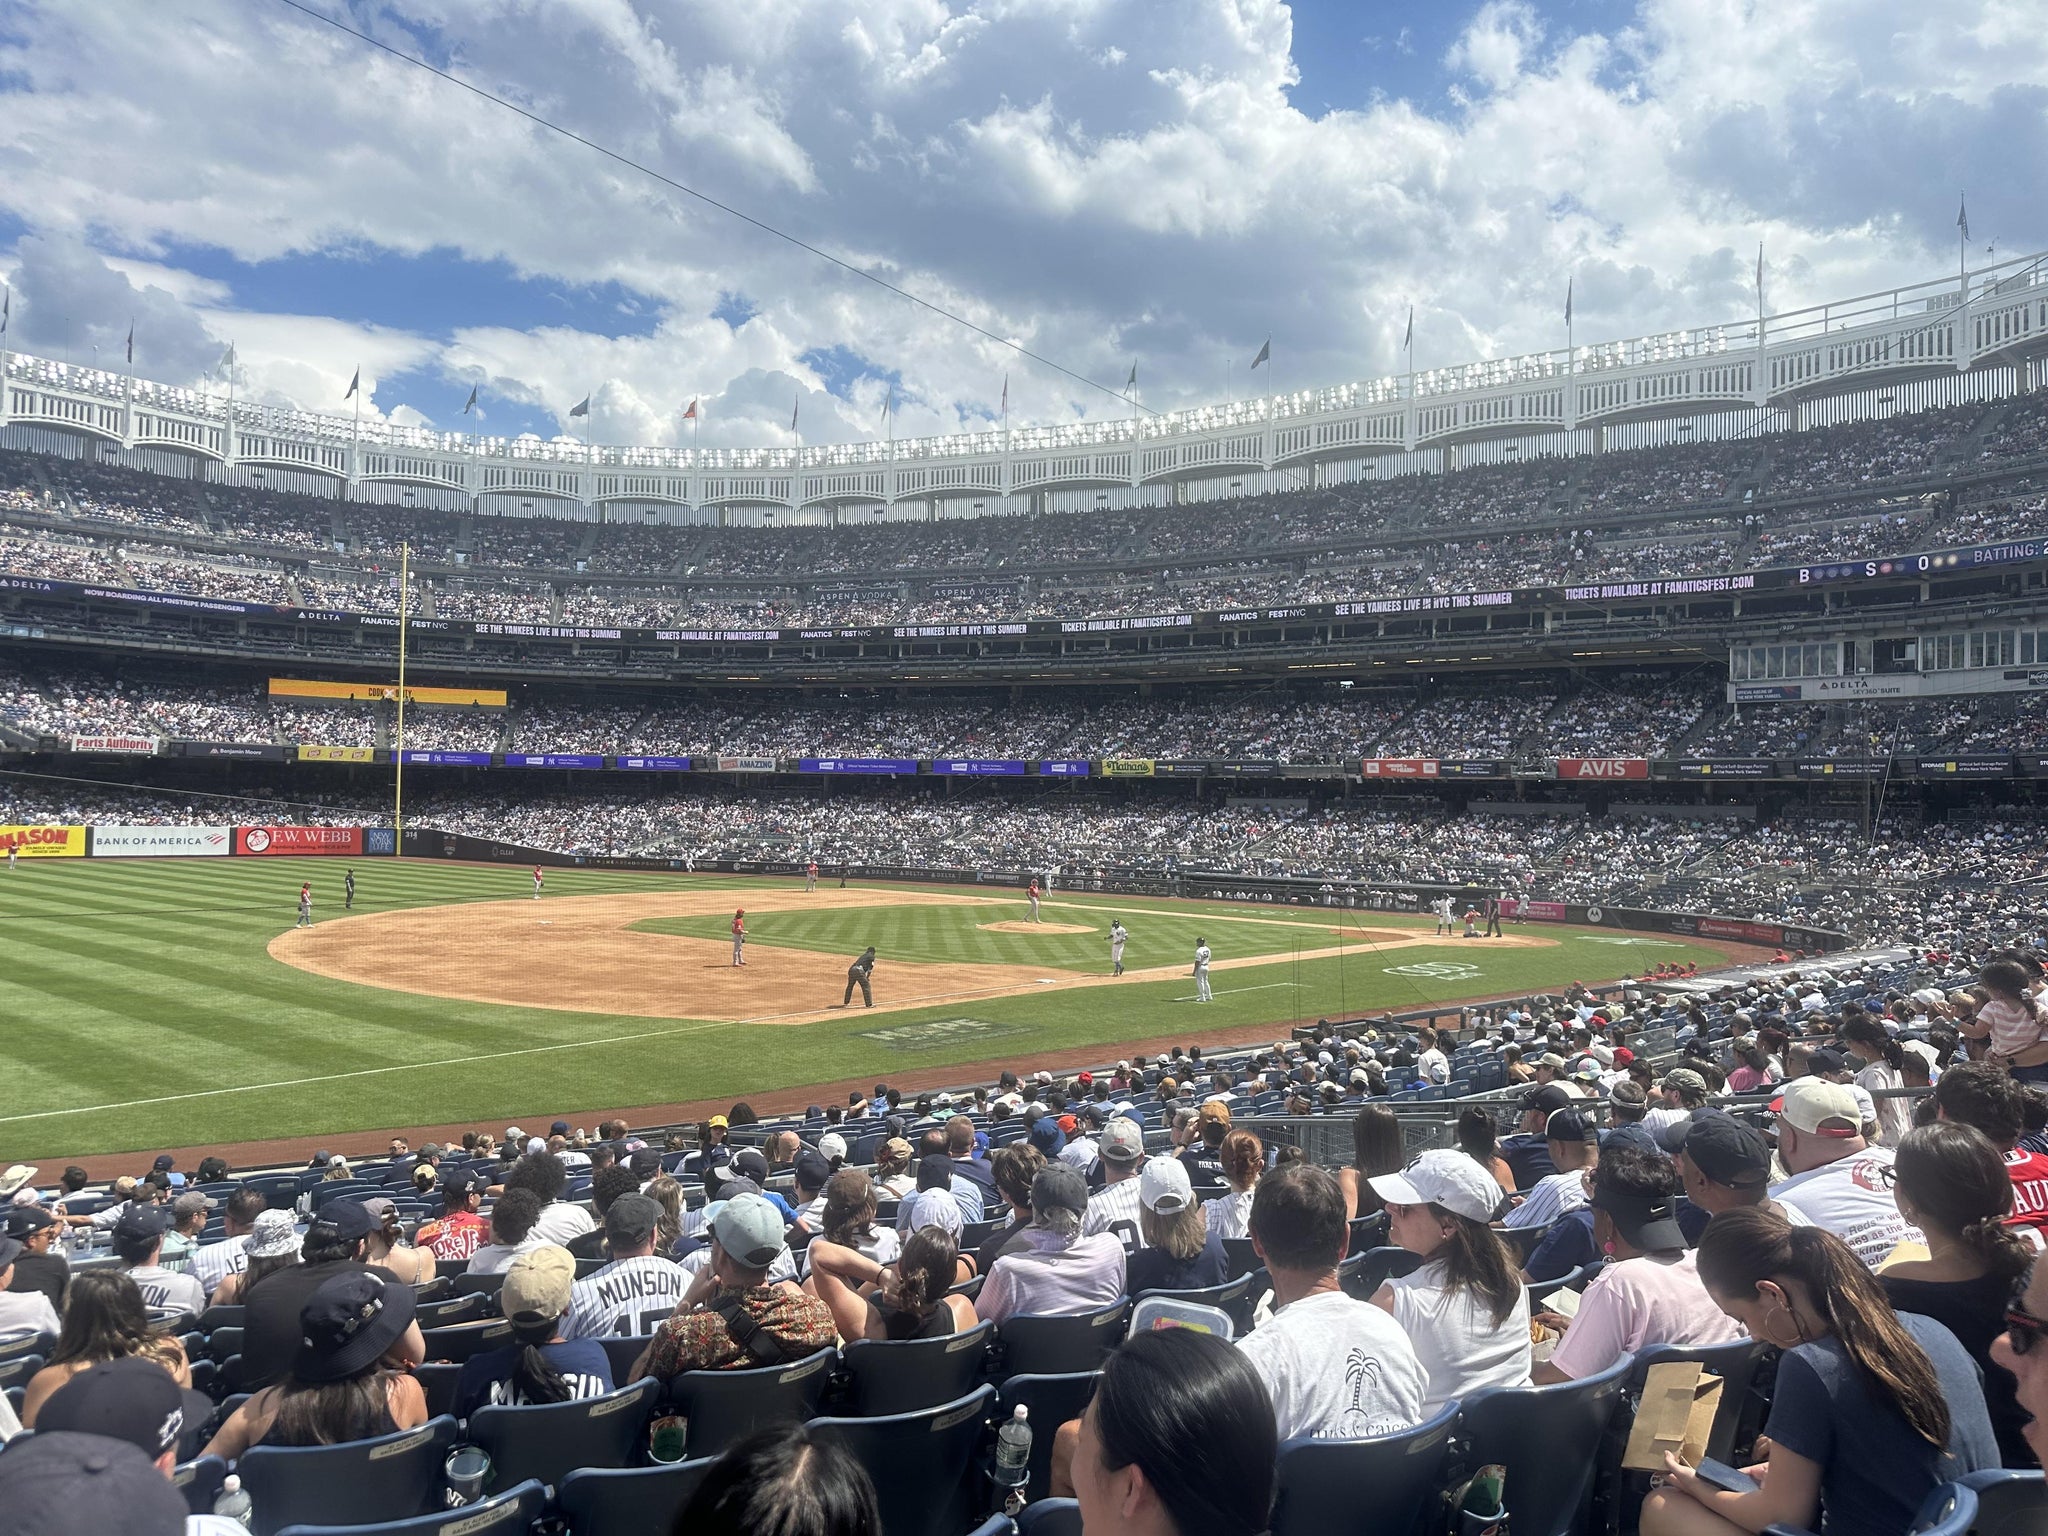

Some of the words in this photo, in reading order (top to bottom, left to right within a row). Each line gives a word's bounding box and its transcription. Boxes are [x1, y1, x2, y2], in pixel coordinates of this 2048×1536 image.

[1974, 543, 2038, 563] BATTING:
[1799, 569, 1810, 583] B
[1865, 563, 1876, 577] S
[12, 579, 51, 591] DELTA
[1565, 587, 1599, 600] TICKETS
[1601, 583, 1648, 599] AVAILABLE
[1649, 582, 1662, 595] AT
[1664, 575, 1754, 594] FANATICSFEST.COM
[820, 592, 850, 601] ASPEN
[862, 591, 892, 600] VODKA
[934, 589, 967, 597] ASPEN
[84, 588, 104, 597] NOW
[106, 590, 147, 602] BOARDING
[147, 595, 162, 603] ALL
[162, 597, 199, 608] PINSTRIPE
[200, 601, 245, 612] PASSENGERS
[1335, 604, 1350, 616] SEE
[1352, 603, 1365, 614] THE
[1367, 600, 1401, 614] YANKEES
[1403, 599, 1421, 611] LIVE
[1433, 598, 1450, 610] NYC
[1451, 596, 1470, 608] THIS
[1472, 592, 1512, 606] SUMMER
[309, 612, 341, 622] DELTA
[1219, 611, 1258, 621] FANATICS
[1268, 610, 1289, 619] FEST
[1289, 608, 1306, 618] NYC
[360, 617, 400, 627] FANATICS
[412, 620, 432, 628] FEST
[432, 622, 448, 630] NYC
[1061, 621, 1086, 633] TICKETS
[1088, 620, 1120, 632] AVAILABLE
[1121, 619, 1129, 630] AT
[1130, 614, 1192, 630] FANATICSFEST.COM
[475, 623, 489, 634] SEE
[491, 624, 503, 634] THE
[504, 625, 534, 636] YANKEES
[535, 626, 551, 637] LIVE
[552, 627, 558, 637] IN
[560, 627, 574, 638] NYC
[575, 628, 590, 638] THIS
[591, 629, 621, 640] SUMMER
[656, 631, 680, 641] TICKETS
[681, 630, 713, 641] AVAILABLE
[714, 630, 722, 640] AT
[723, 630, 779, 641] FANATICSFEST.COM
[800, 630, 832, 639] FANATICS
[841, 630, 858, 638] FEST
[858, 629, 871, 638] NYC
[894, 627, 906, 638] SEE
[906, 627, 917, 637] THE
[919, 626, 945, 637] YANKEES
[946, 626, 960, 636] LIVE
[961, 625, 968, 636] IN
[969, 625, 981, 636] NYC
[982, 625, 996, 635] THIS
[998, 624, 1027, 634] SUMMER
[1831, 680, 1868, 689] DELTA
[368, 687, 384, 696] COOK
[76, 738, 104, 748] Parts
[106, 738, 154, 750] Authority
[220, 748, 244, 756] Benjamin
[740, 760, 772, 769] AMAZING
[1107, 760, 1150, 773] Nathan's
[1578, 761, 1626, 776] AVIS
[150, 837, 202, 845] AMERICA
[272, 830, 300, 843] F.W.
[301, 830, 352, 843] WEBB
[1871, 1231, 1885, 1241] as
[1886, 1224, 1903, 1234] the
[597, 1270, 681, 1310] MUNSON
